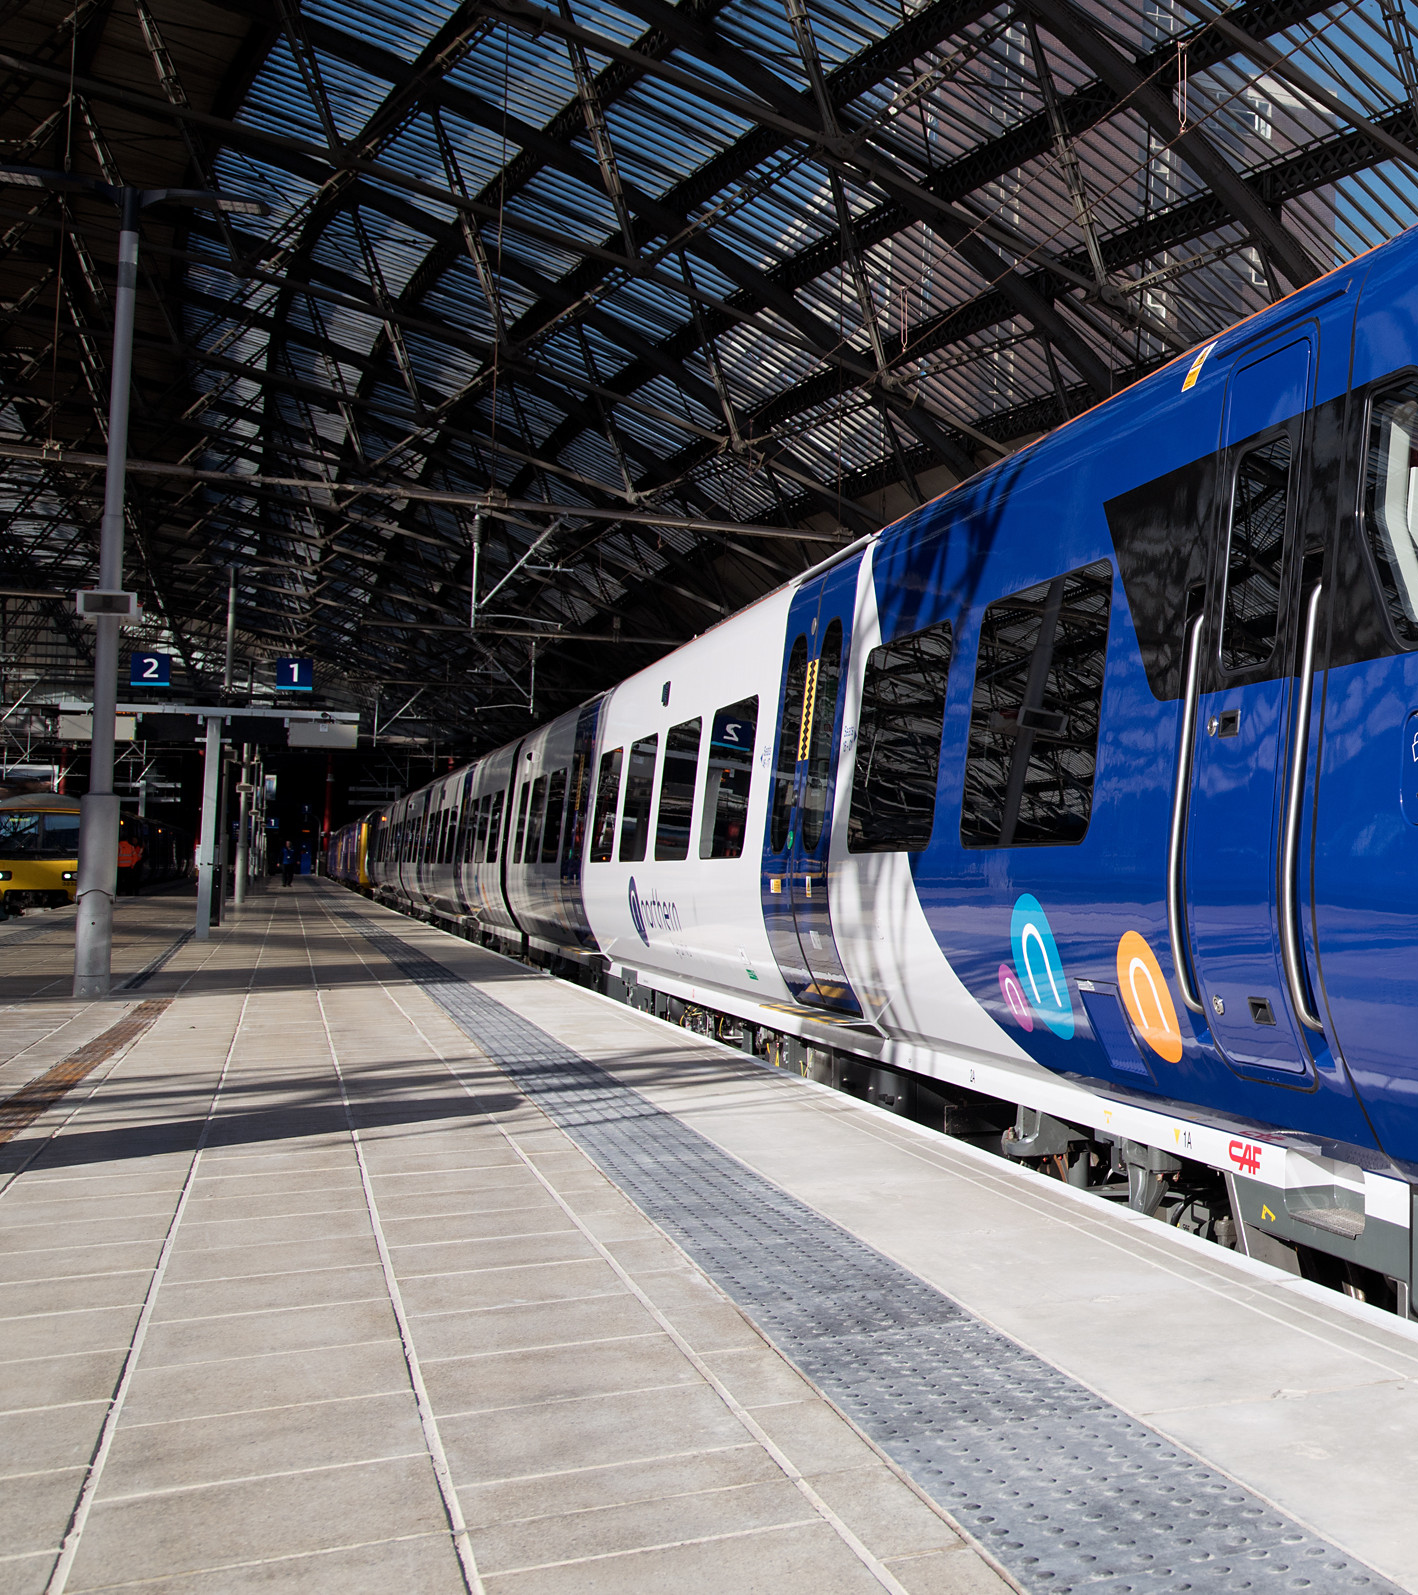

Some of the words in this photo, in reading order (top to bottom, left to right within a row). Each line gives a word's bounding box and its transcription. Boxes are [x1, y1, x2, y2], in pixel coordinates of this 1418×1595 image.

[142, 658, 159, 678] 2
[289, 663, 299, 683] 1
[270, 819, 275, 827] 1
[641, 887, 683, 932] northern
[1183, 1128, 1193, 1150] 1A
[1228, 1139, 1262, 1175] CAF
